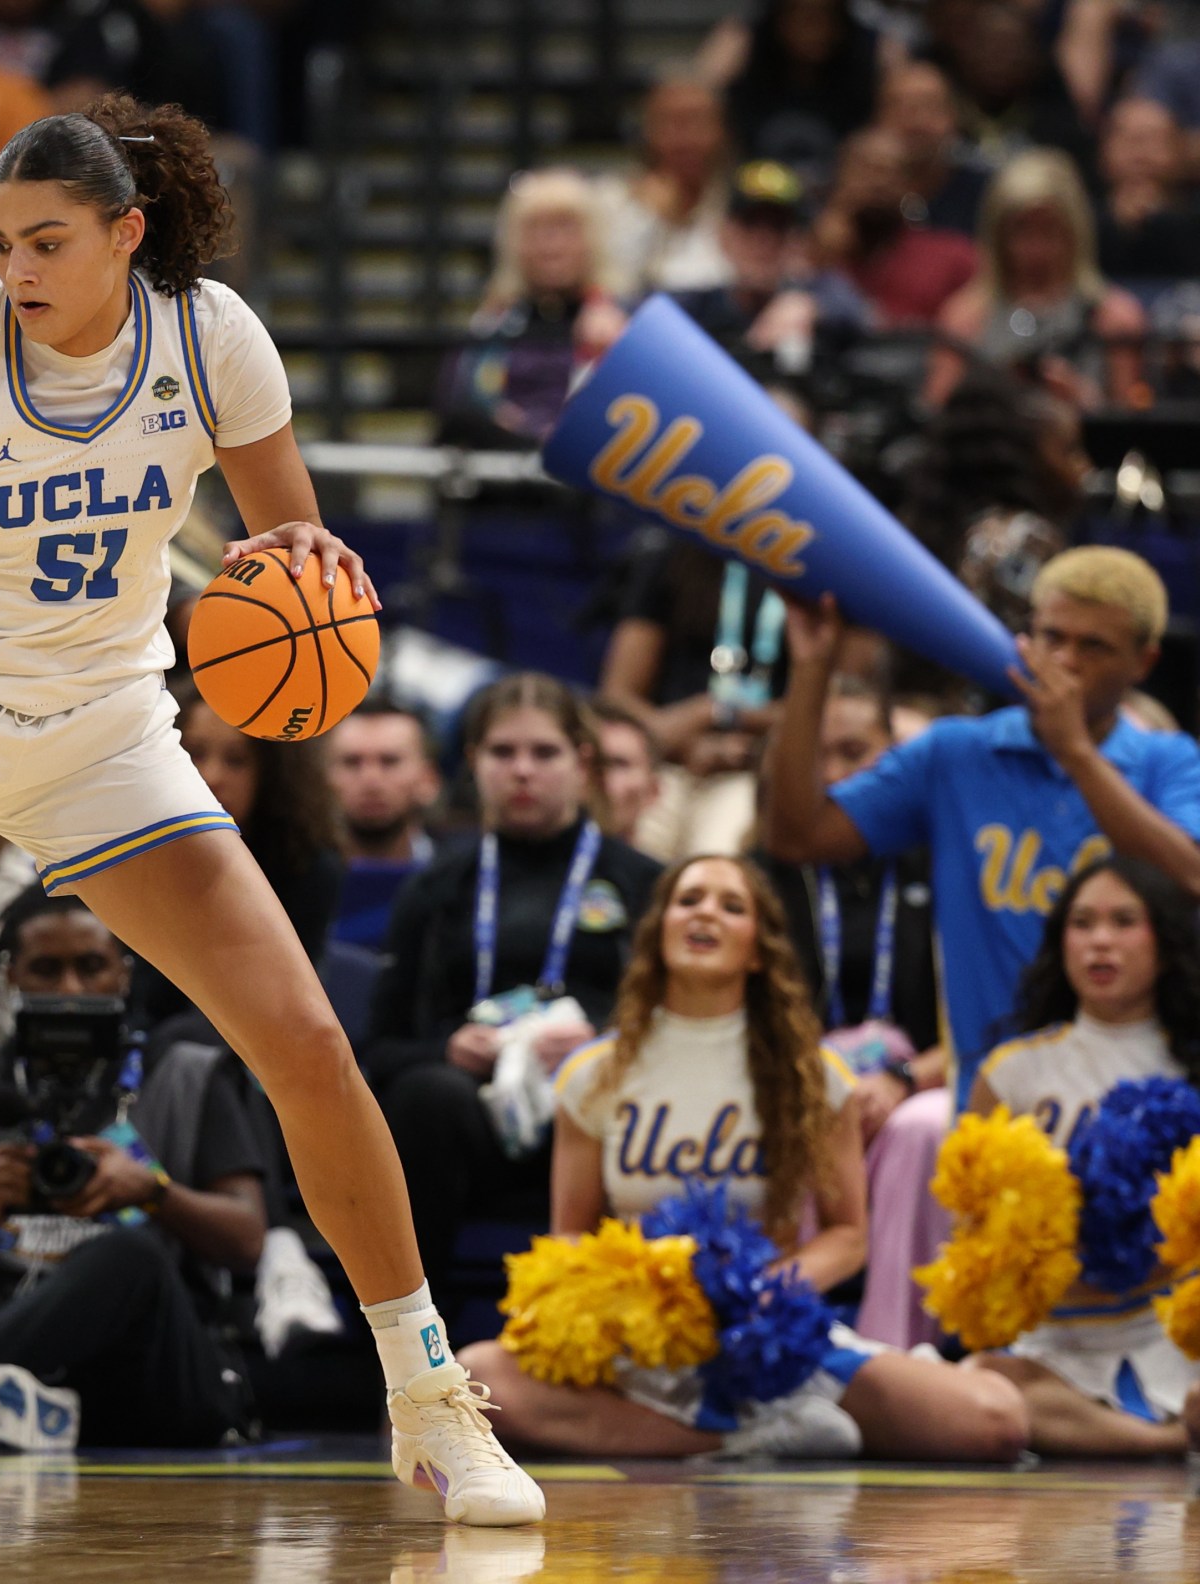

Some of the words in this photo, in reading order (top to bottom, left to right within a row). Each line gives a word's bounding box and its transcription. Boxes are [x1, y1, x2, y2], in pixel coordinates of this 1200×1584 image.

[590, 393, 814, 578] Ucla
[30, 528, 128, 602] 51
[615, 1102, 768, 1178] Ucla
